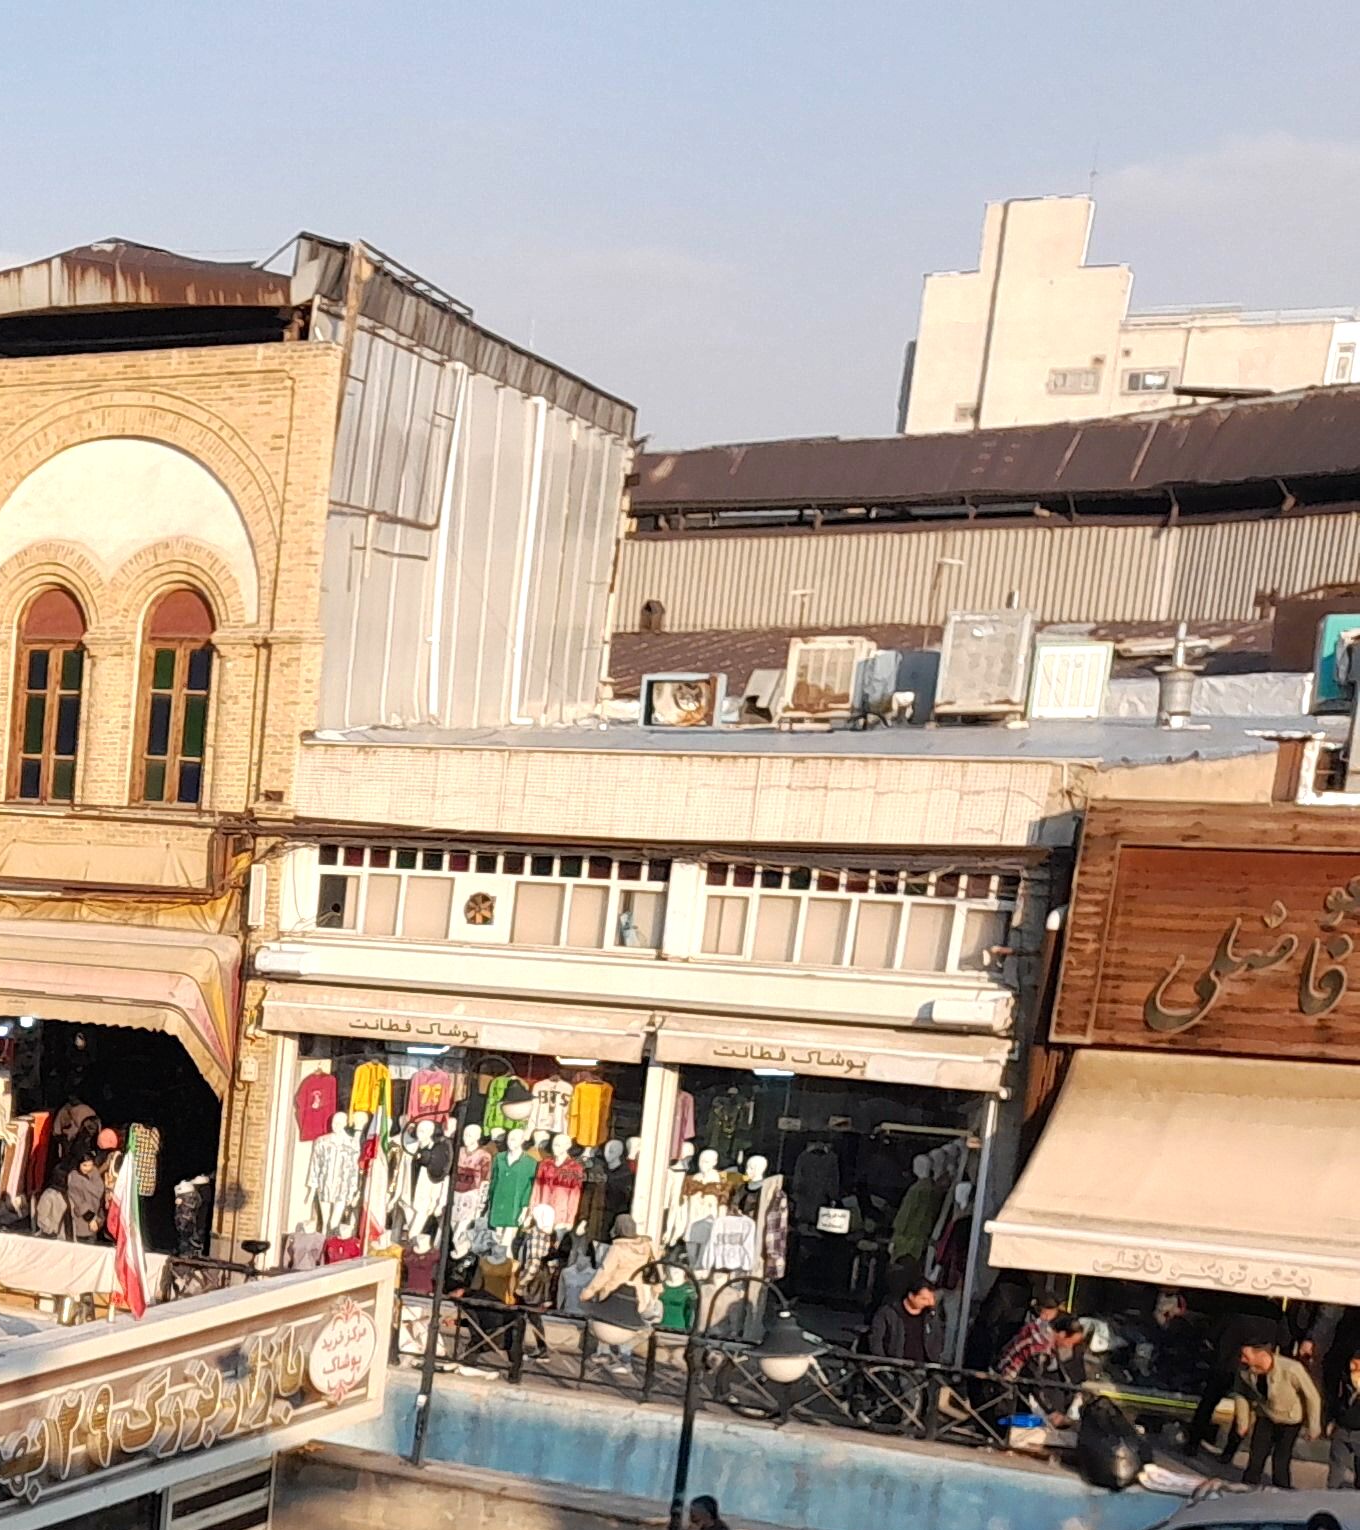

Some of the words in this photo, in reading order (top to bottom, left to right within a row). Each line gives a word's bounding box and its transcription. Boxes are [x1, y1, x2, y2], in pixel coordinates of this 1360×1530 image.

[1143, 900, 1354, 1034] فاضلی
[348, 1017, 412, 1034] فطانت
[415, 1022, 480, 1045] پوشاک
[713, 1045, 786, 1063] فطانت
[791, 1051, 868, 1077] پوشاک
[537, 1090, 571, 1108] BTS
[321, 1330, 345, 1352] خرید
[344, 1325, 367, 1347] مرکز
[322, 1352, 363, 1374] پوشاک
[211, 1325, 306, 1441] بازار
[118, 1358, 222, 1458] بزرگ
[48, 1382, 115, 1480] ۲۹
